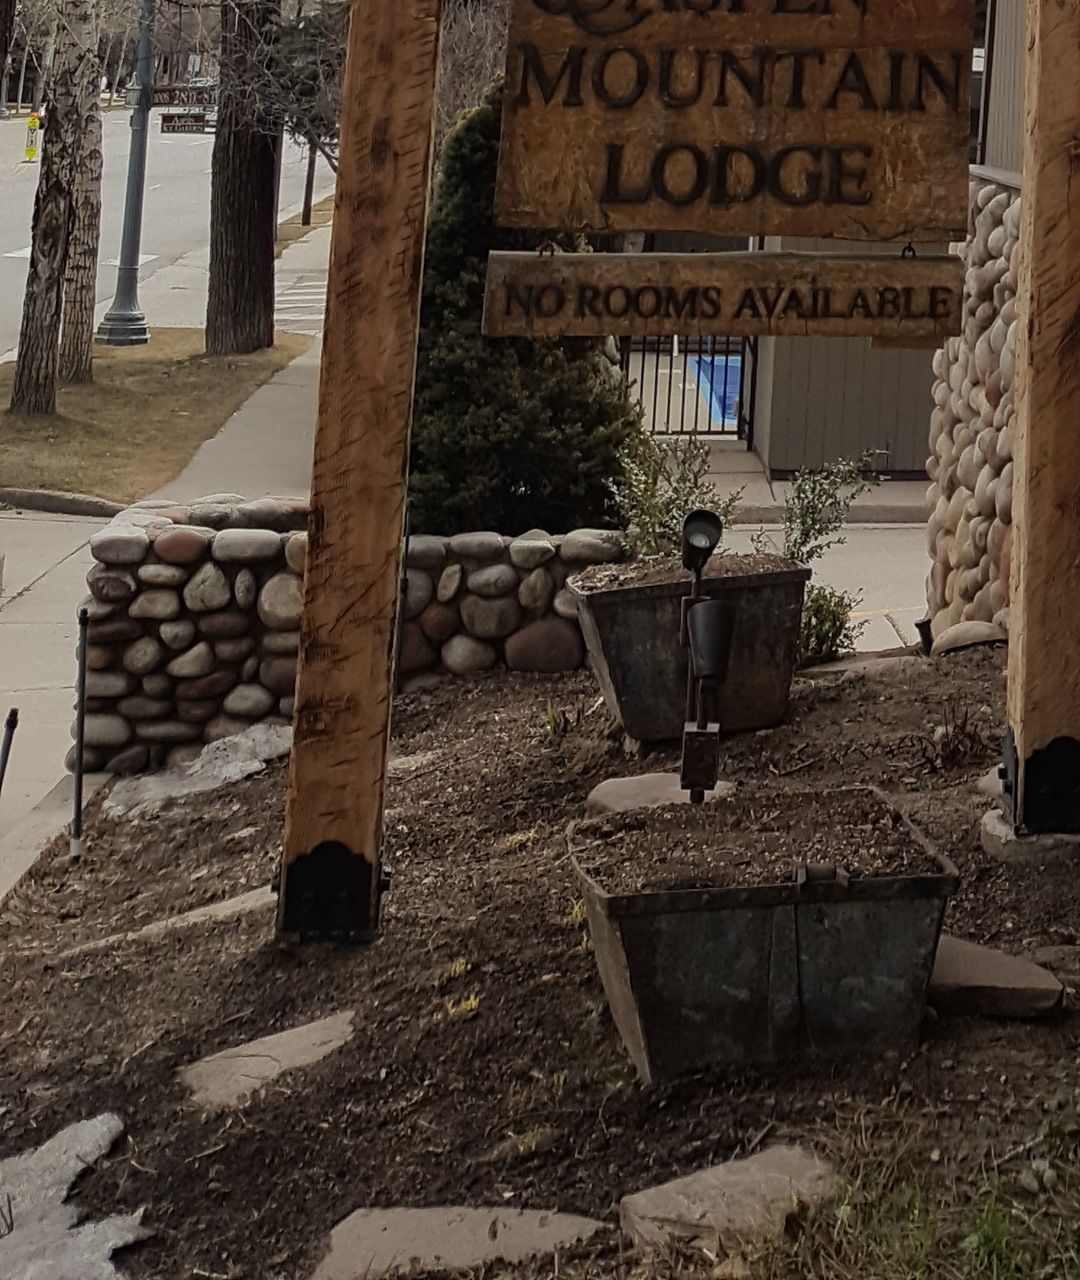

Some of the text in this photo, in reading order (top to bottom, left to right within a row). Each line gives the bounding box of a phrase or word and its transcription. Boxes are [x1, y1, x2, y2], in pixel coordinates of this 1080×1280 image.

[512, 42, 964, 113] MOUNTAIN
[602, 142, 873, 208] LODGE
[504, 284, 955, 320] NO ROOMS AVAILABLE
